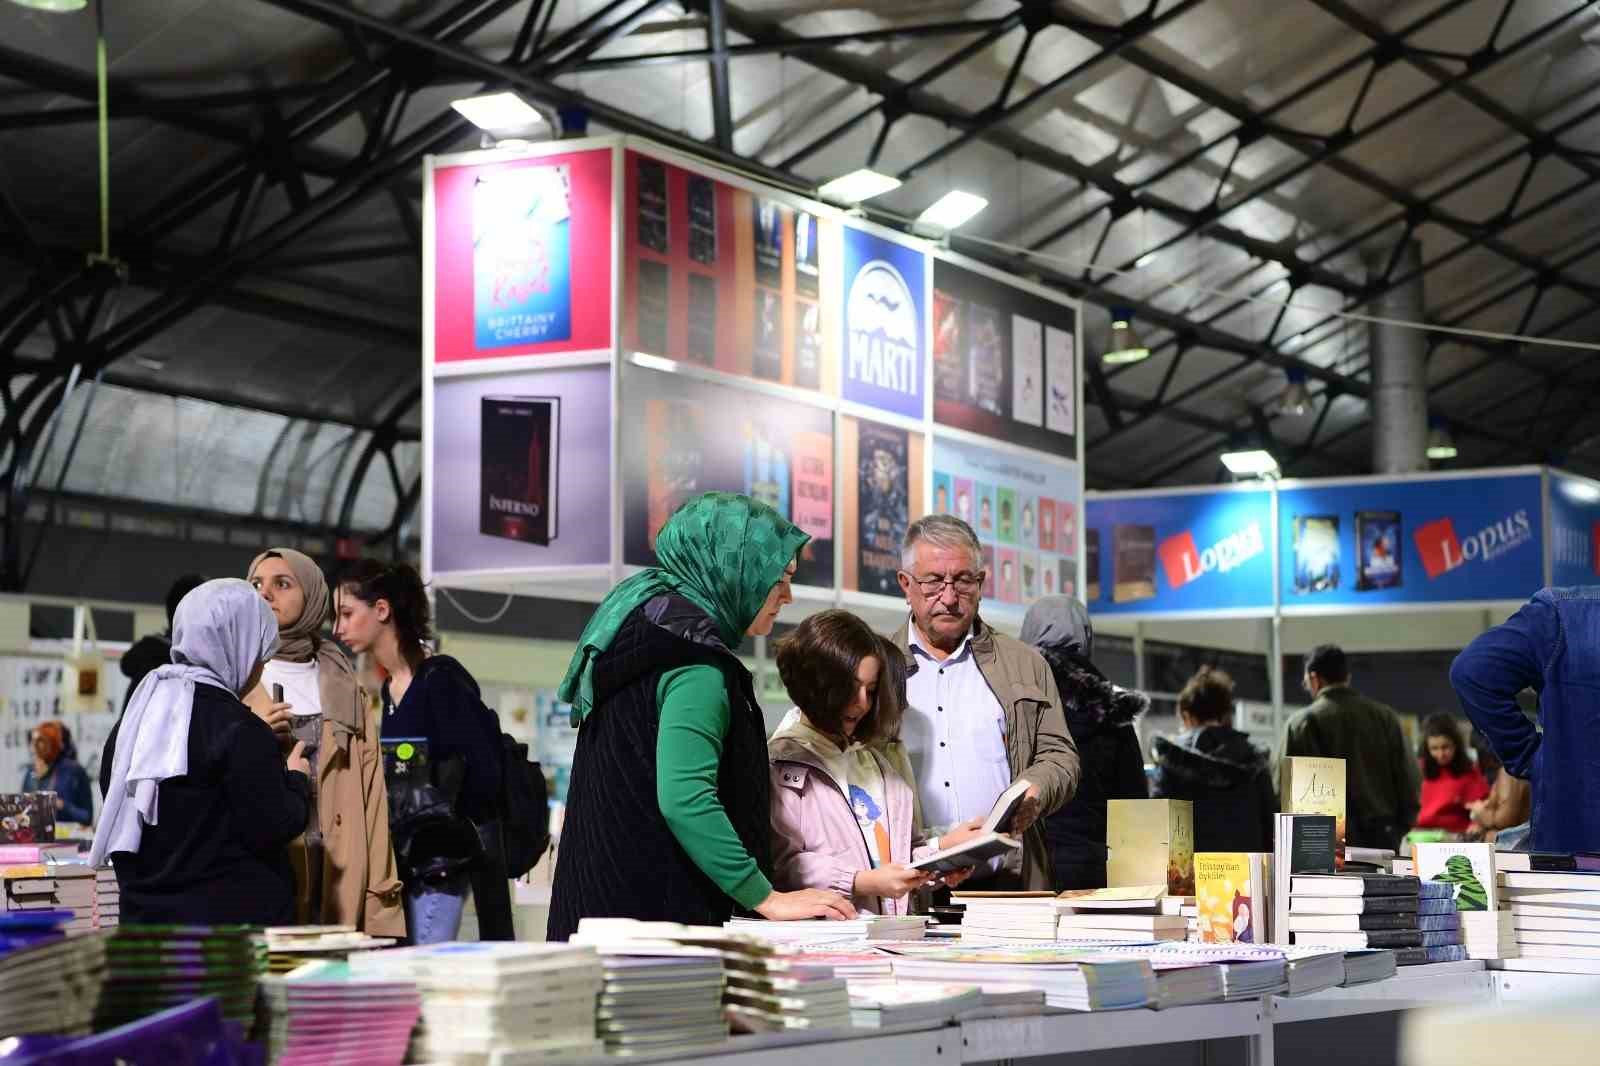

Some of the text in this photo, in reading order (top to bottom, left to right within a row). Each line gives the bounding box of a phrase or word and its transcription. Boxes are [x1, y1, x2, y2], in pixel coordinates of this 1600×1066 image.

[487, 312, 556, 330] BRITTAINY
[495, 324, 549, 340] CHERRY
[848, 332, 917, 396] MARTI
[1441, 508, 1530, 572] Lopus
